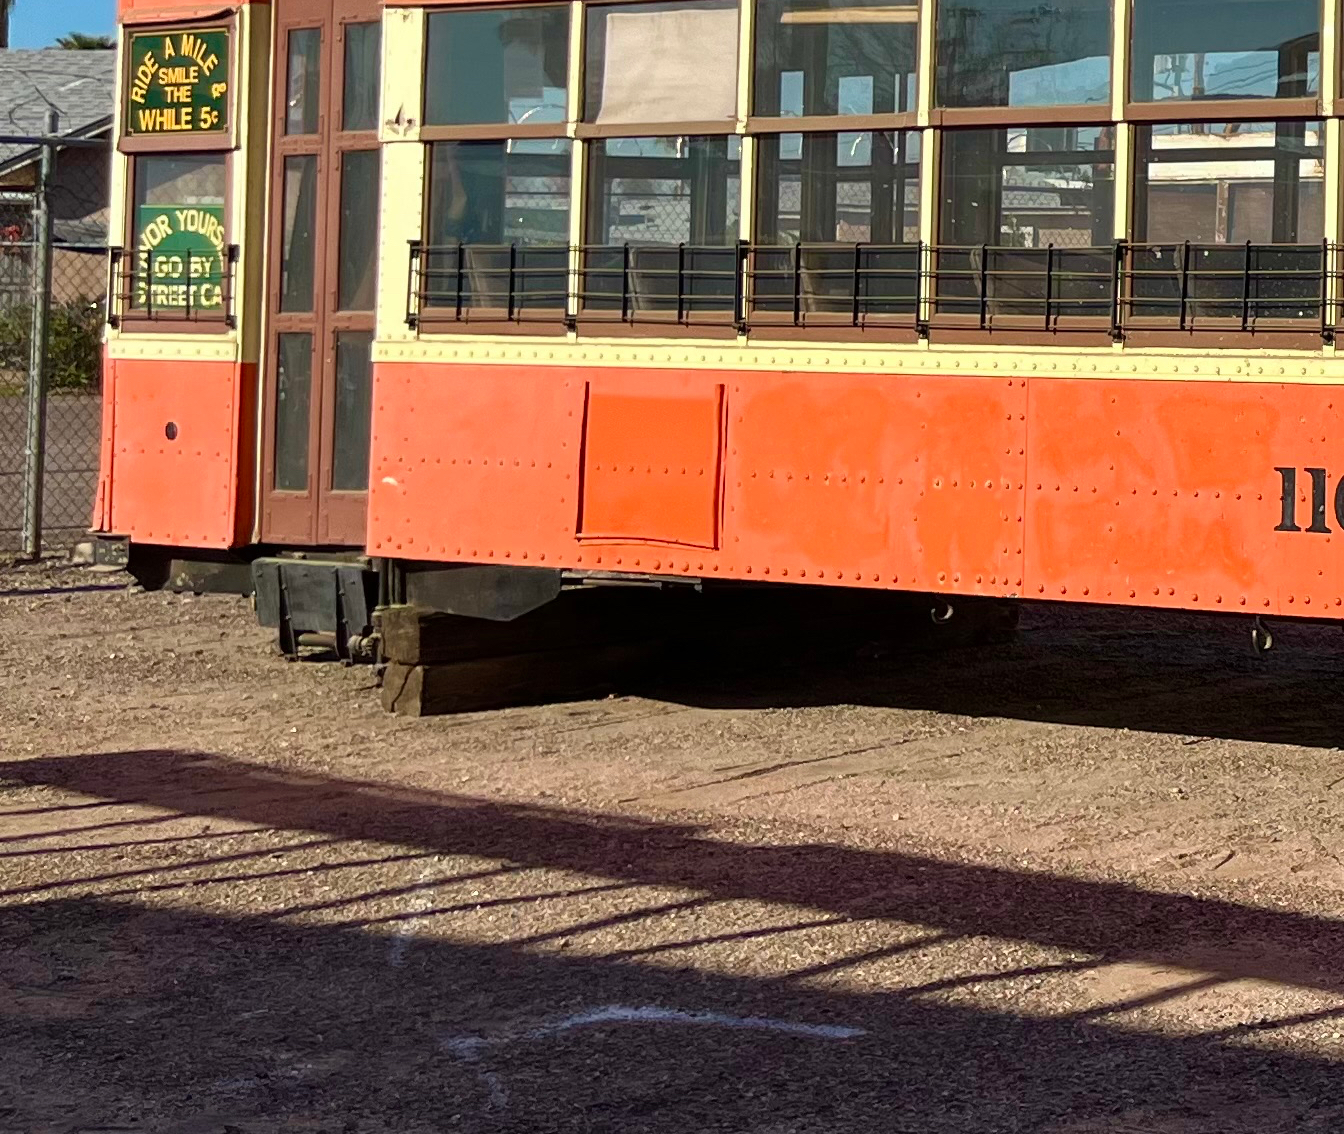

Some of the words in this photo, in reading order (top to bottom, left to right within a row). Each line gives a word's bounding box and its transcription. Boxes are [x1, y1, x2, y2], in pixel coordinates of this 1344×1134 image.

[131, 51, 159, 104] RIDE
[164, 36, 176, 61] A
[181, 33, 219, 77] MILE
[158, 66, 199, 85] SMILE
[164, 85, 192, 104] THE
[139, 107, 193, 132] WHILE
[154, 255, 183, 278] GO
[190, 255, 214, 278] BY
[201, 283, 222, 307] CA
